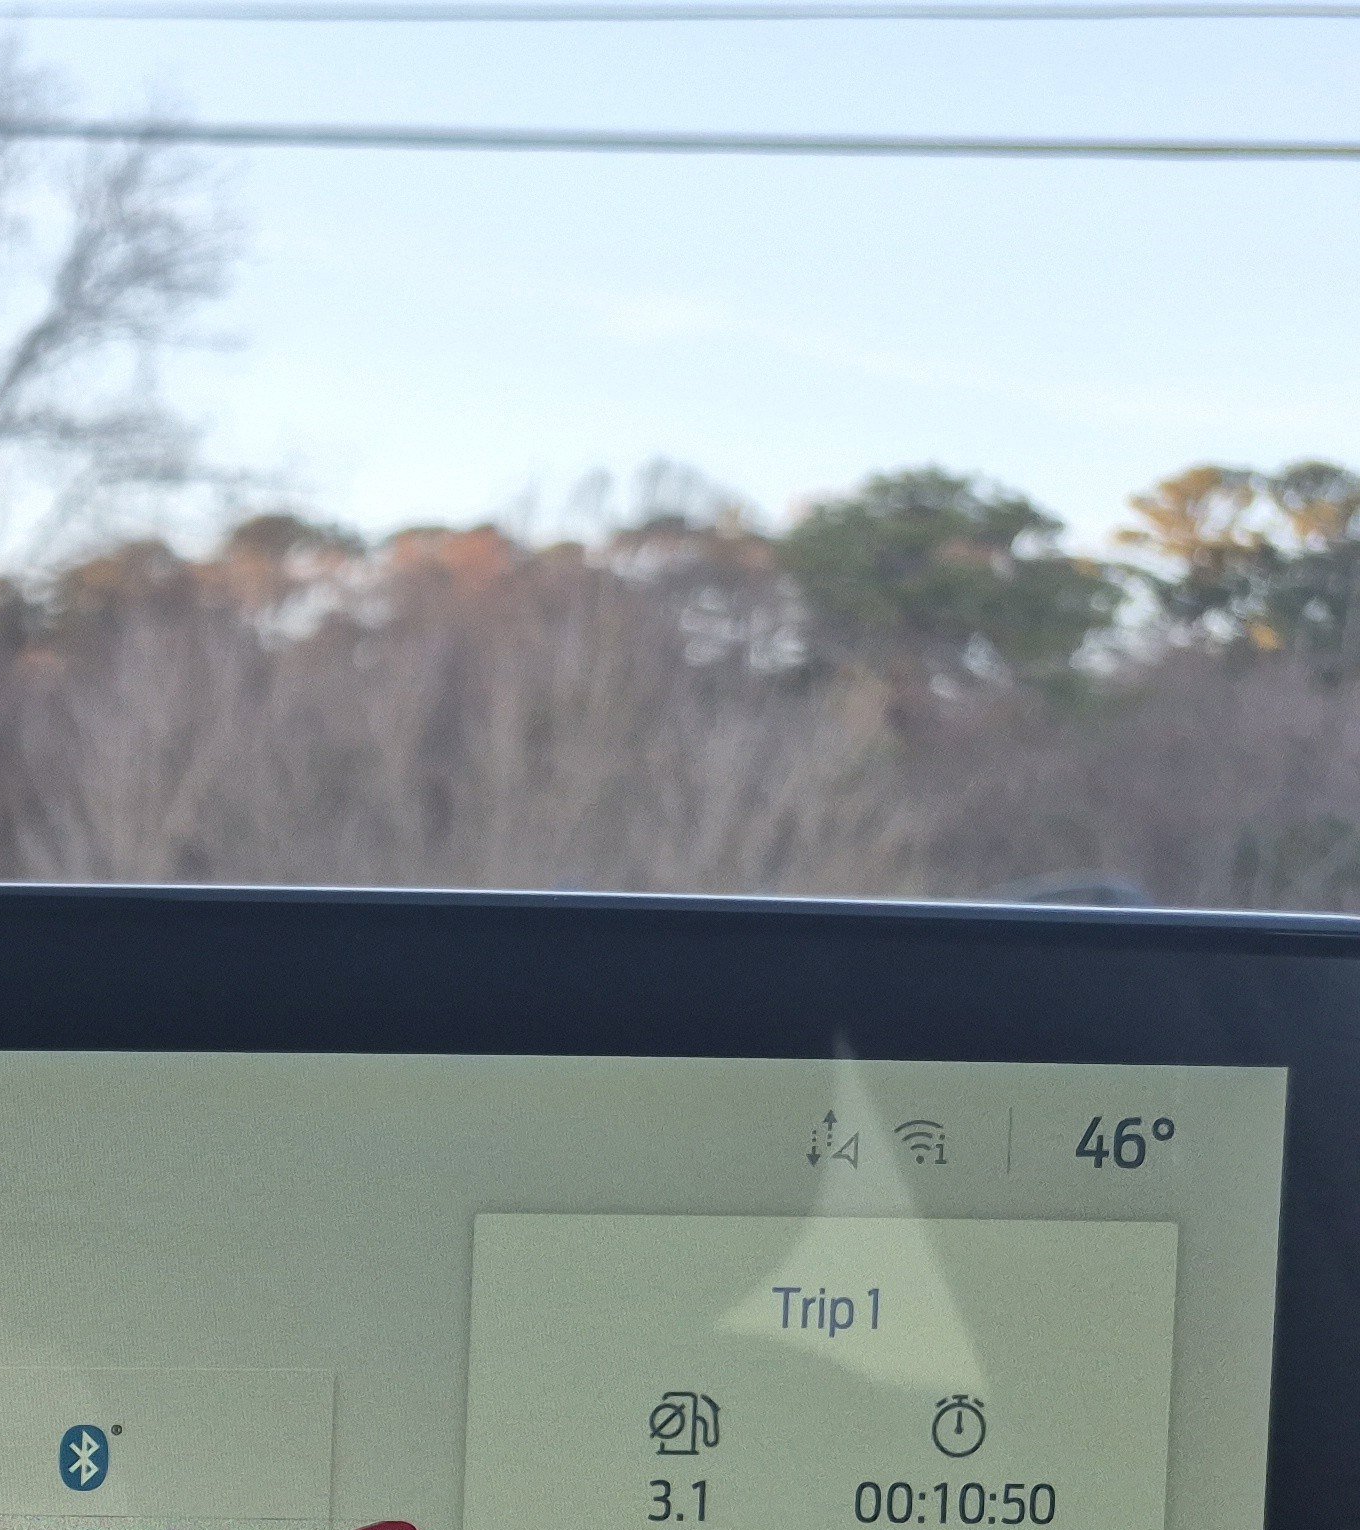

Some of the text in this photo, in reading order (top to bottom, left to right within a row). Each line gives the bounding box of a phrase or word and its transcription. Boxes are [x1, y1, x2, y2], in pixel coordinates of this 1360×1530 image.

[1076, 1116, 1177, 1170] 46°
[772, 1287, 882, 1338] Trip 1
[648, 1480, 710, 1523] 3.1
[853, 1482, 1057, 1525] 00:10:50
